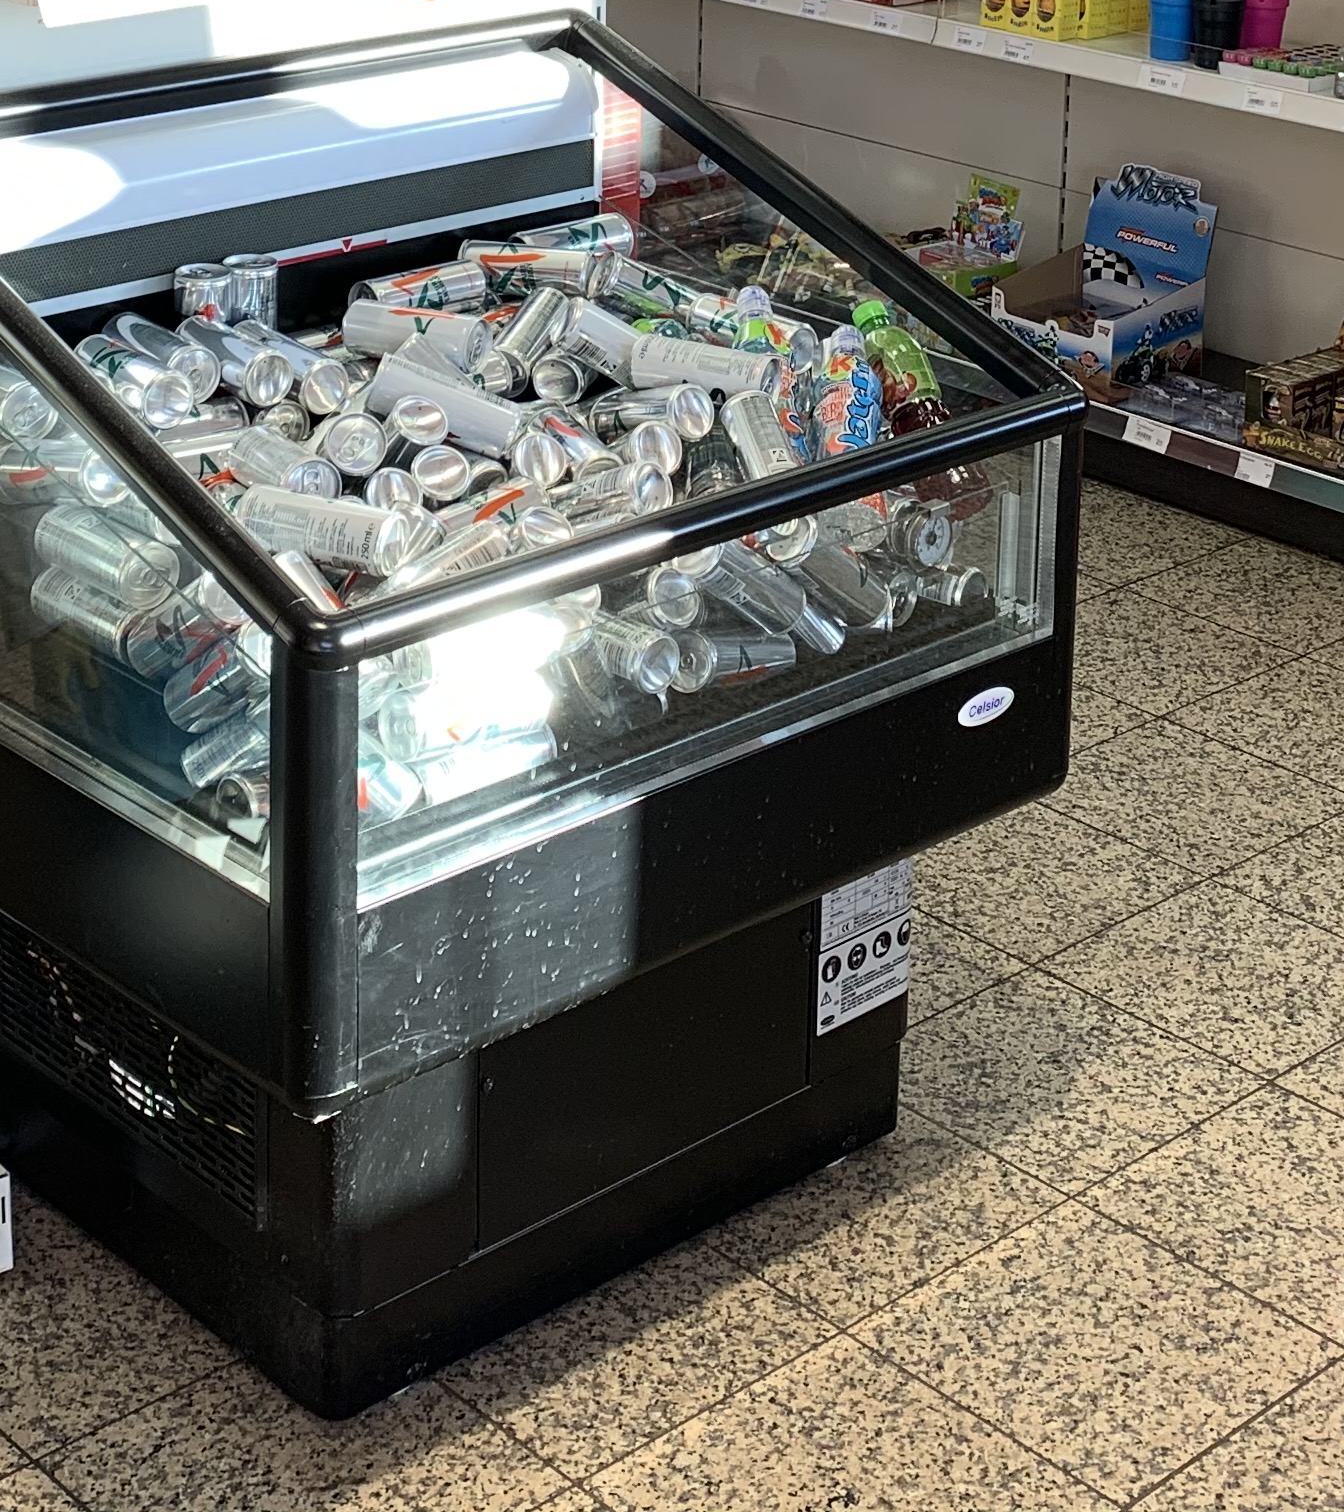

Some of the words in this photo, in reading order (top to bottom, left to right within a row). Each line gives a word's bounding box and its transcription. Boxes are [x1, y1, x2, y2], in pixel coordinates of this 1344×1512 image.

[1116, 230, 1178, 253] POWERFUL
[1258, 429, 1296, 450] SNAKE
[1298, 441, 1323, 459] EGG
[968, 695, 1006, 719] Celsior
